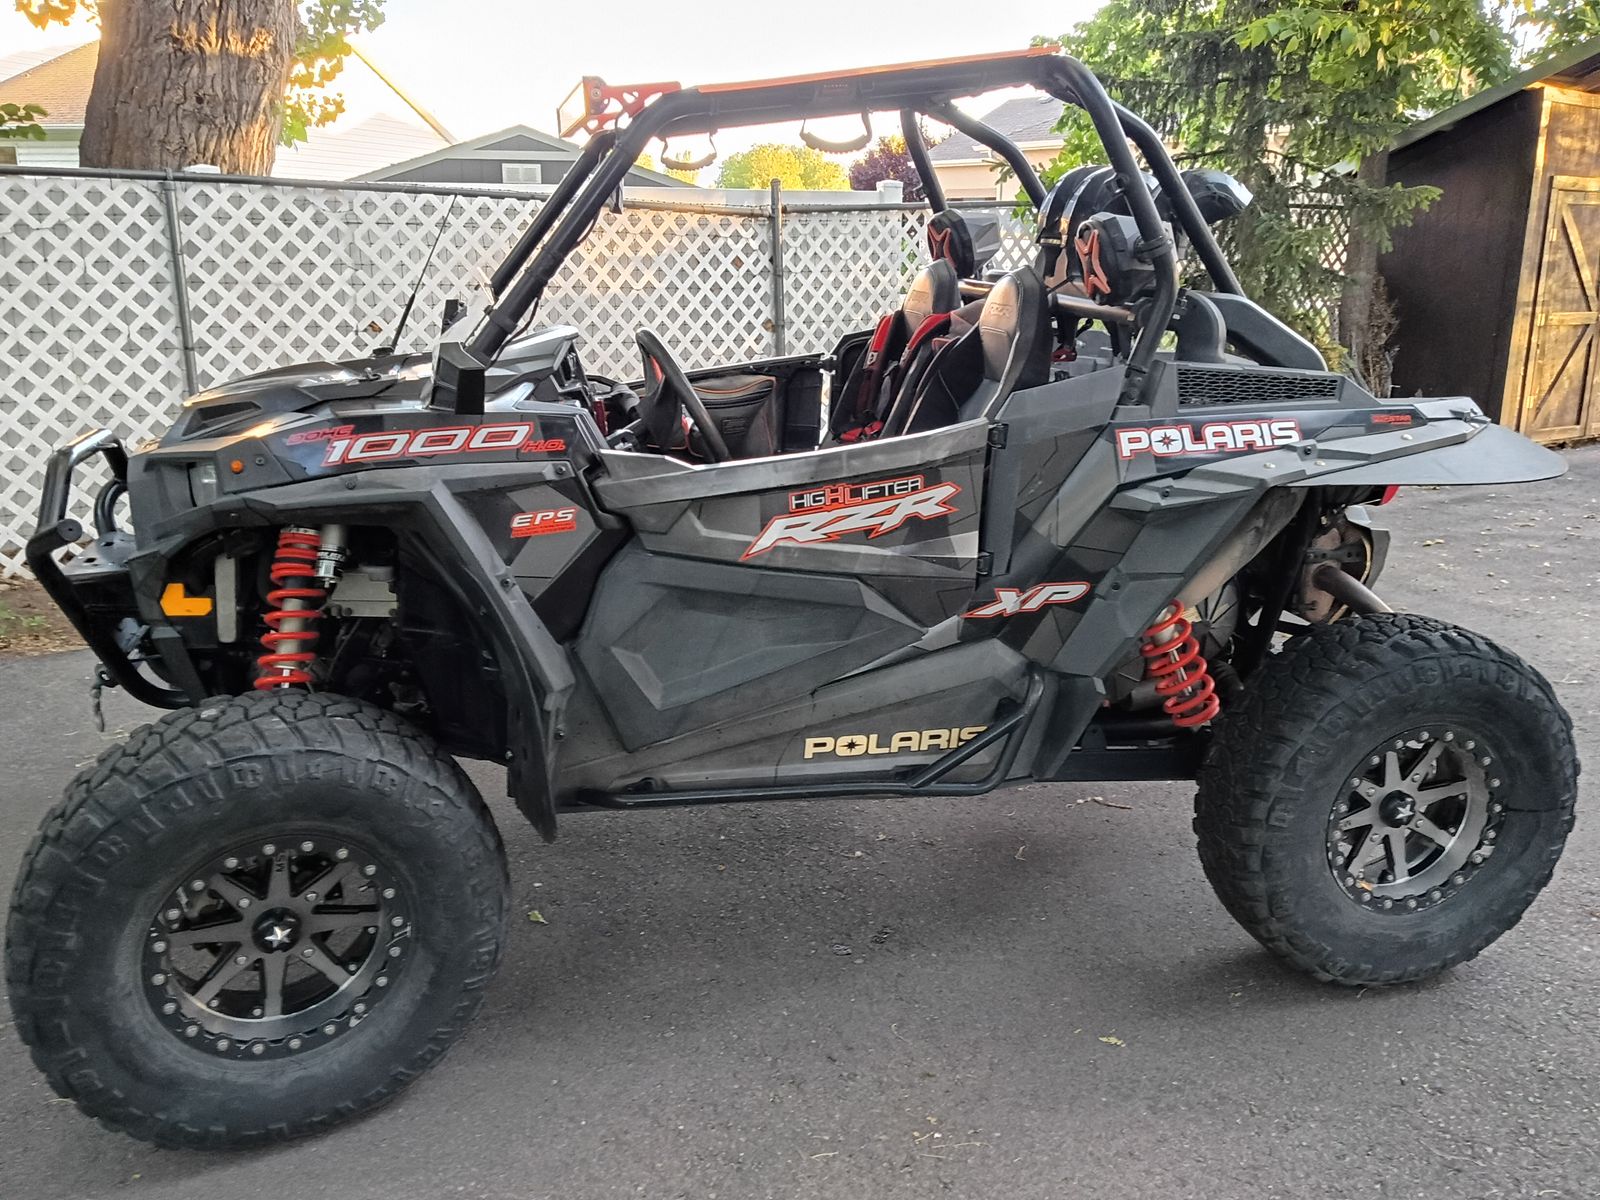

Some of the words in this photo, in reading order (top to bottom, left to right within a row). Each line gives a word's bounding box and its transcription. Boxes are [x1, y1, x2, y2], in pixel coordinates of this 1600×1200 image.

[324, 423, 532, 466] 1000
[1117, 420, 1301, 459] POLARIS
[511, 508, 577, 528] EPS
[743, 482, 959, 559] RZR
[962, 582, 1091, 617] XP
[803, 725, 988, 759] POLARIS
